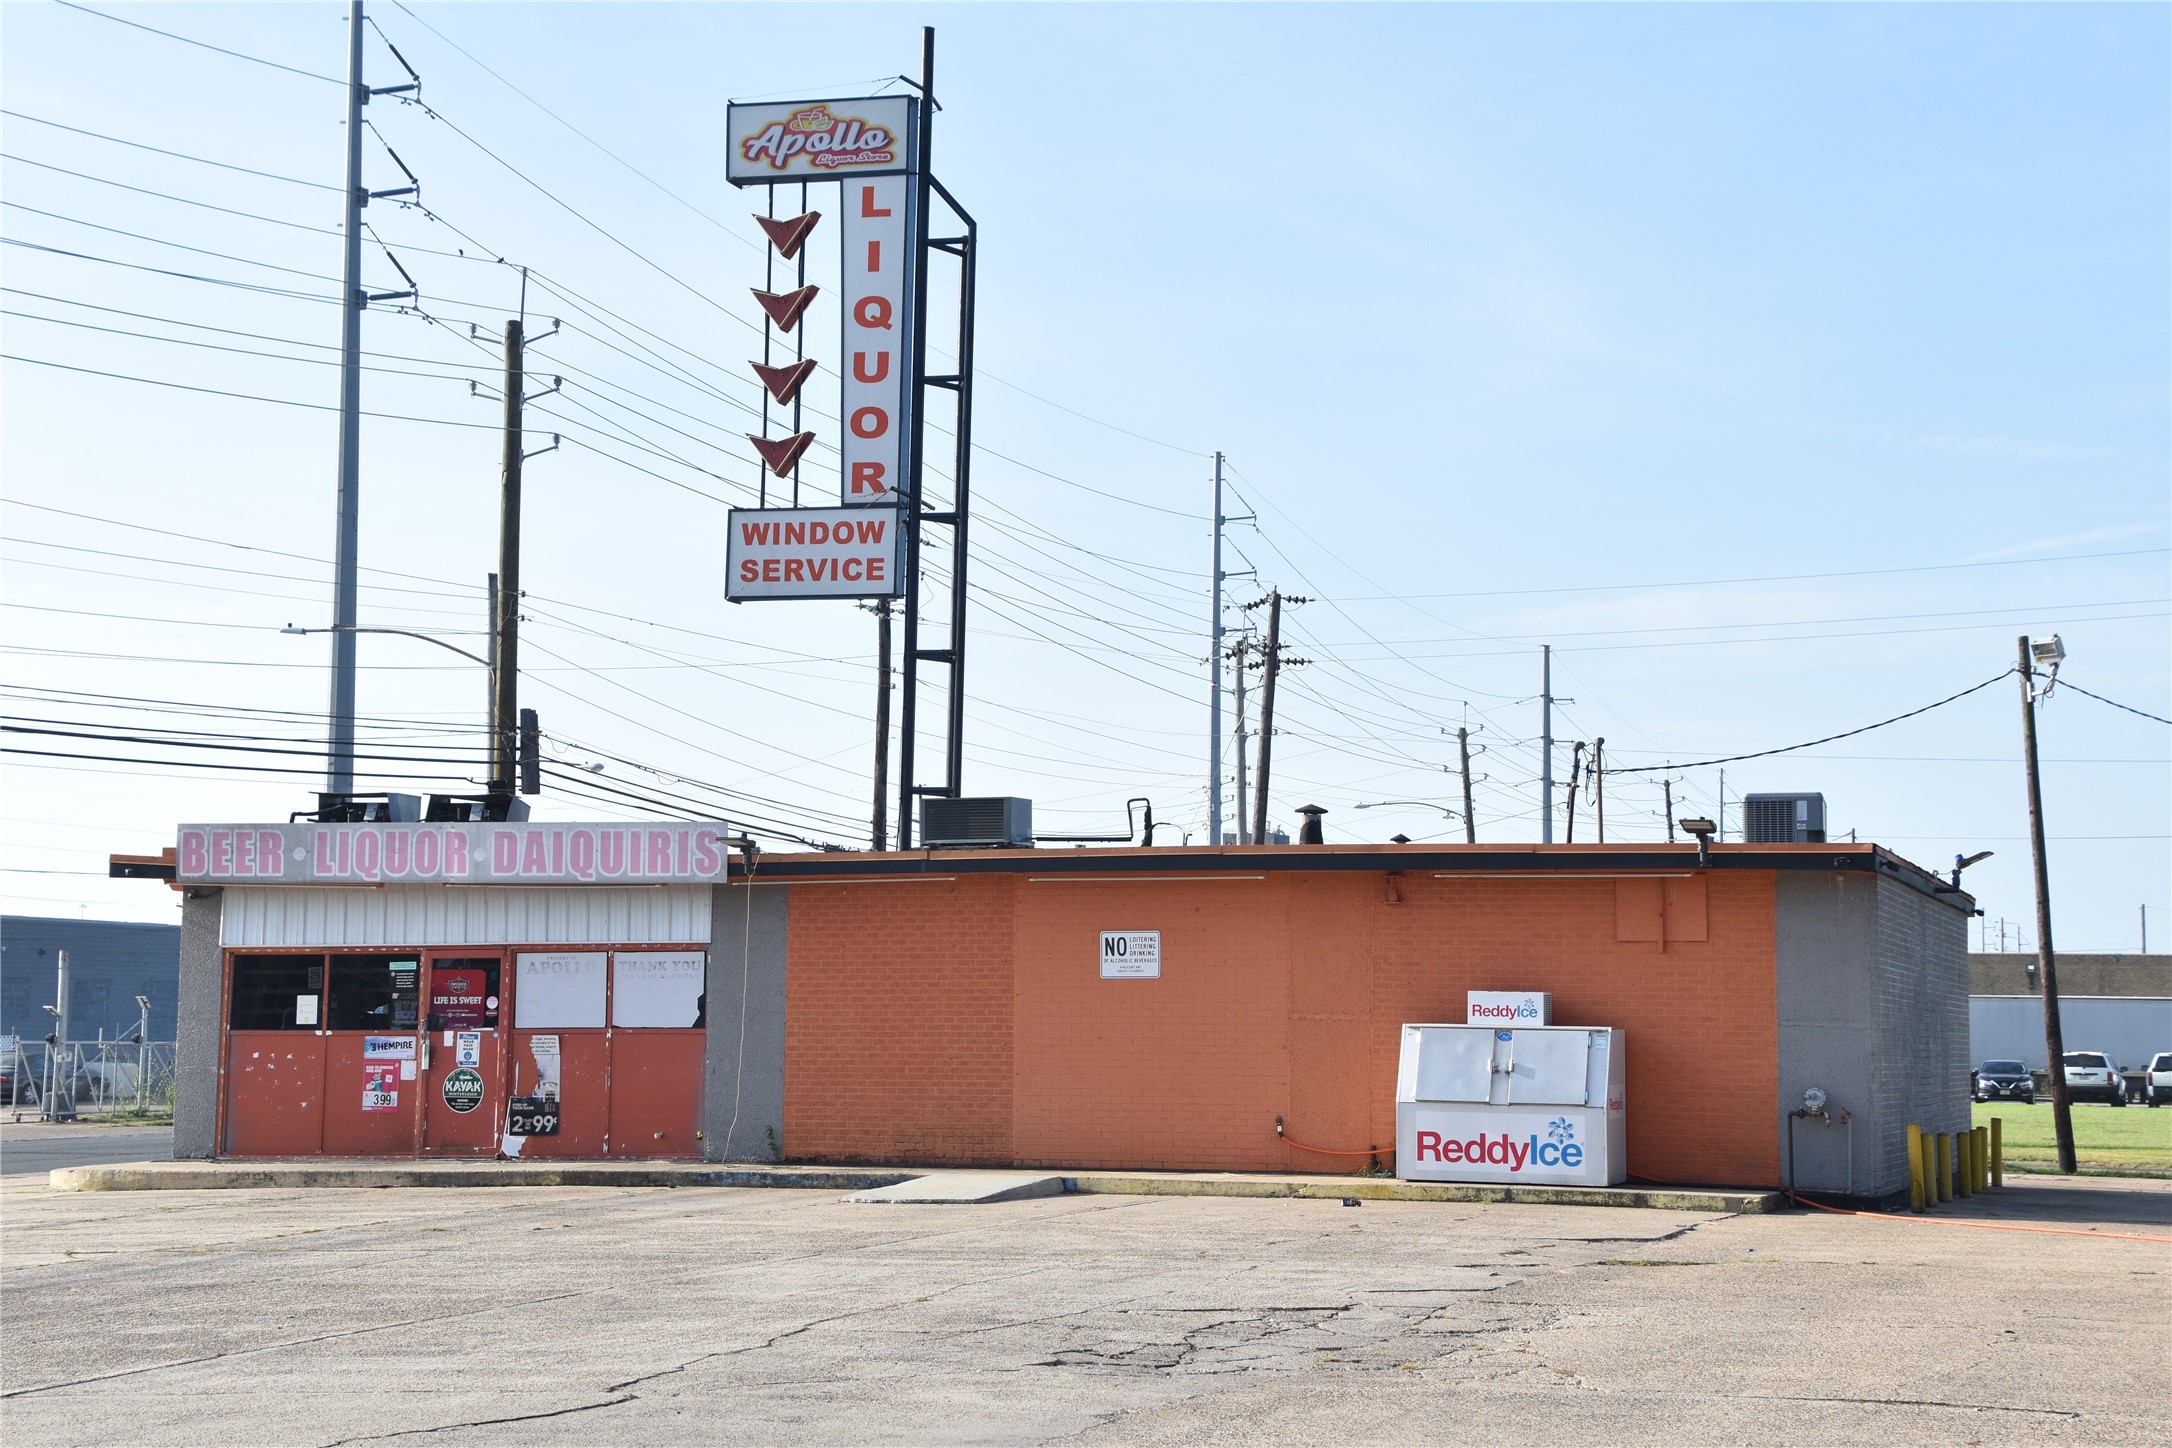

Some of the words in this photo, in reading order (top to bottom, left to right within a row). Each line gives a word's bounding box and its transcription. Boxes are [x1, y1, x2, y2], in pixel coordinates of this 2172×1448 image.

[747, 121, 891, 167] Apollo
[816, 153, 855, 165] Liquor
[858, 152, 890, 162] Store
[850, 186, 893, 494] LIQUOR
[741, 521, 885, 545] WINDOW
[740, 558, 885, 582] SERVICE
[179, 829, 285, 876] BEER
[313, 828, 468, 881] LIQUOR
[491, 828, 721, 881] DAIQUIRIS
[1105, 937, 1127, 956] NO
[619, 960, 667, 971] THANK
[672, 960, 701, 971] YOU
[1472, 1004, 1538, 1020] ReddyIce
[378, 1041, 413, 1050] HEMPIRE
[446, 1081, 480, 1092] KAYAK
[512, 1116, 523, 1132] 2
[1417, 1131, 1583, 1171] ReddyIce
